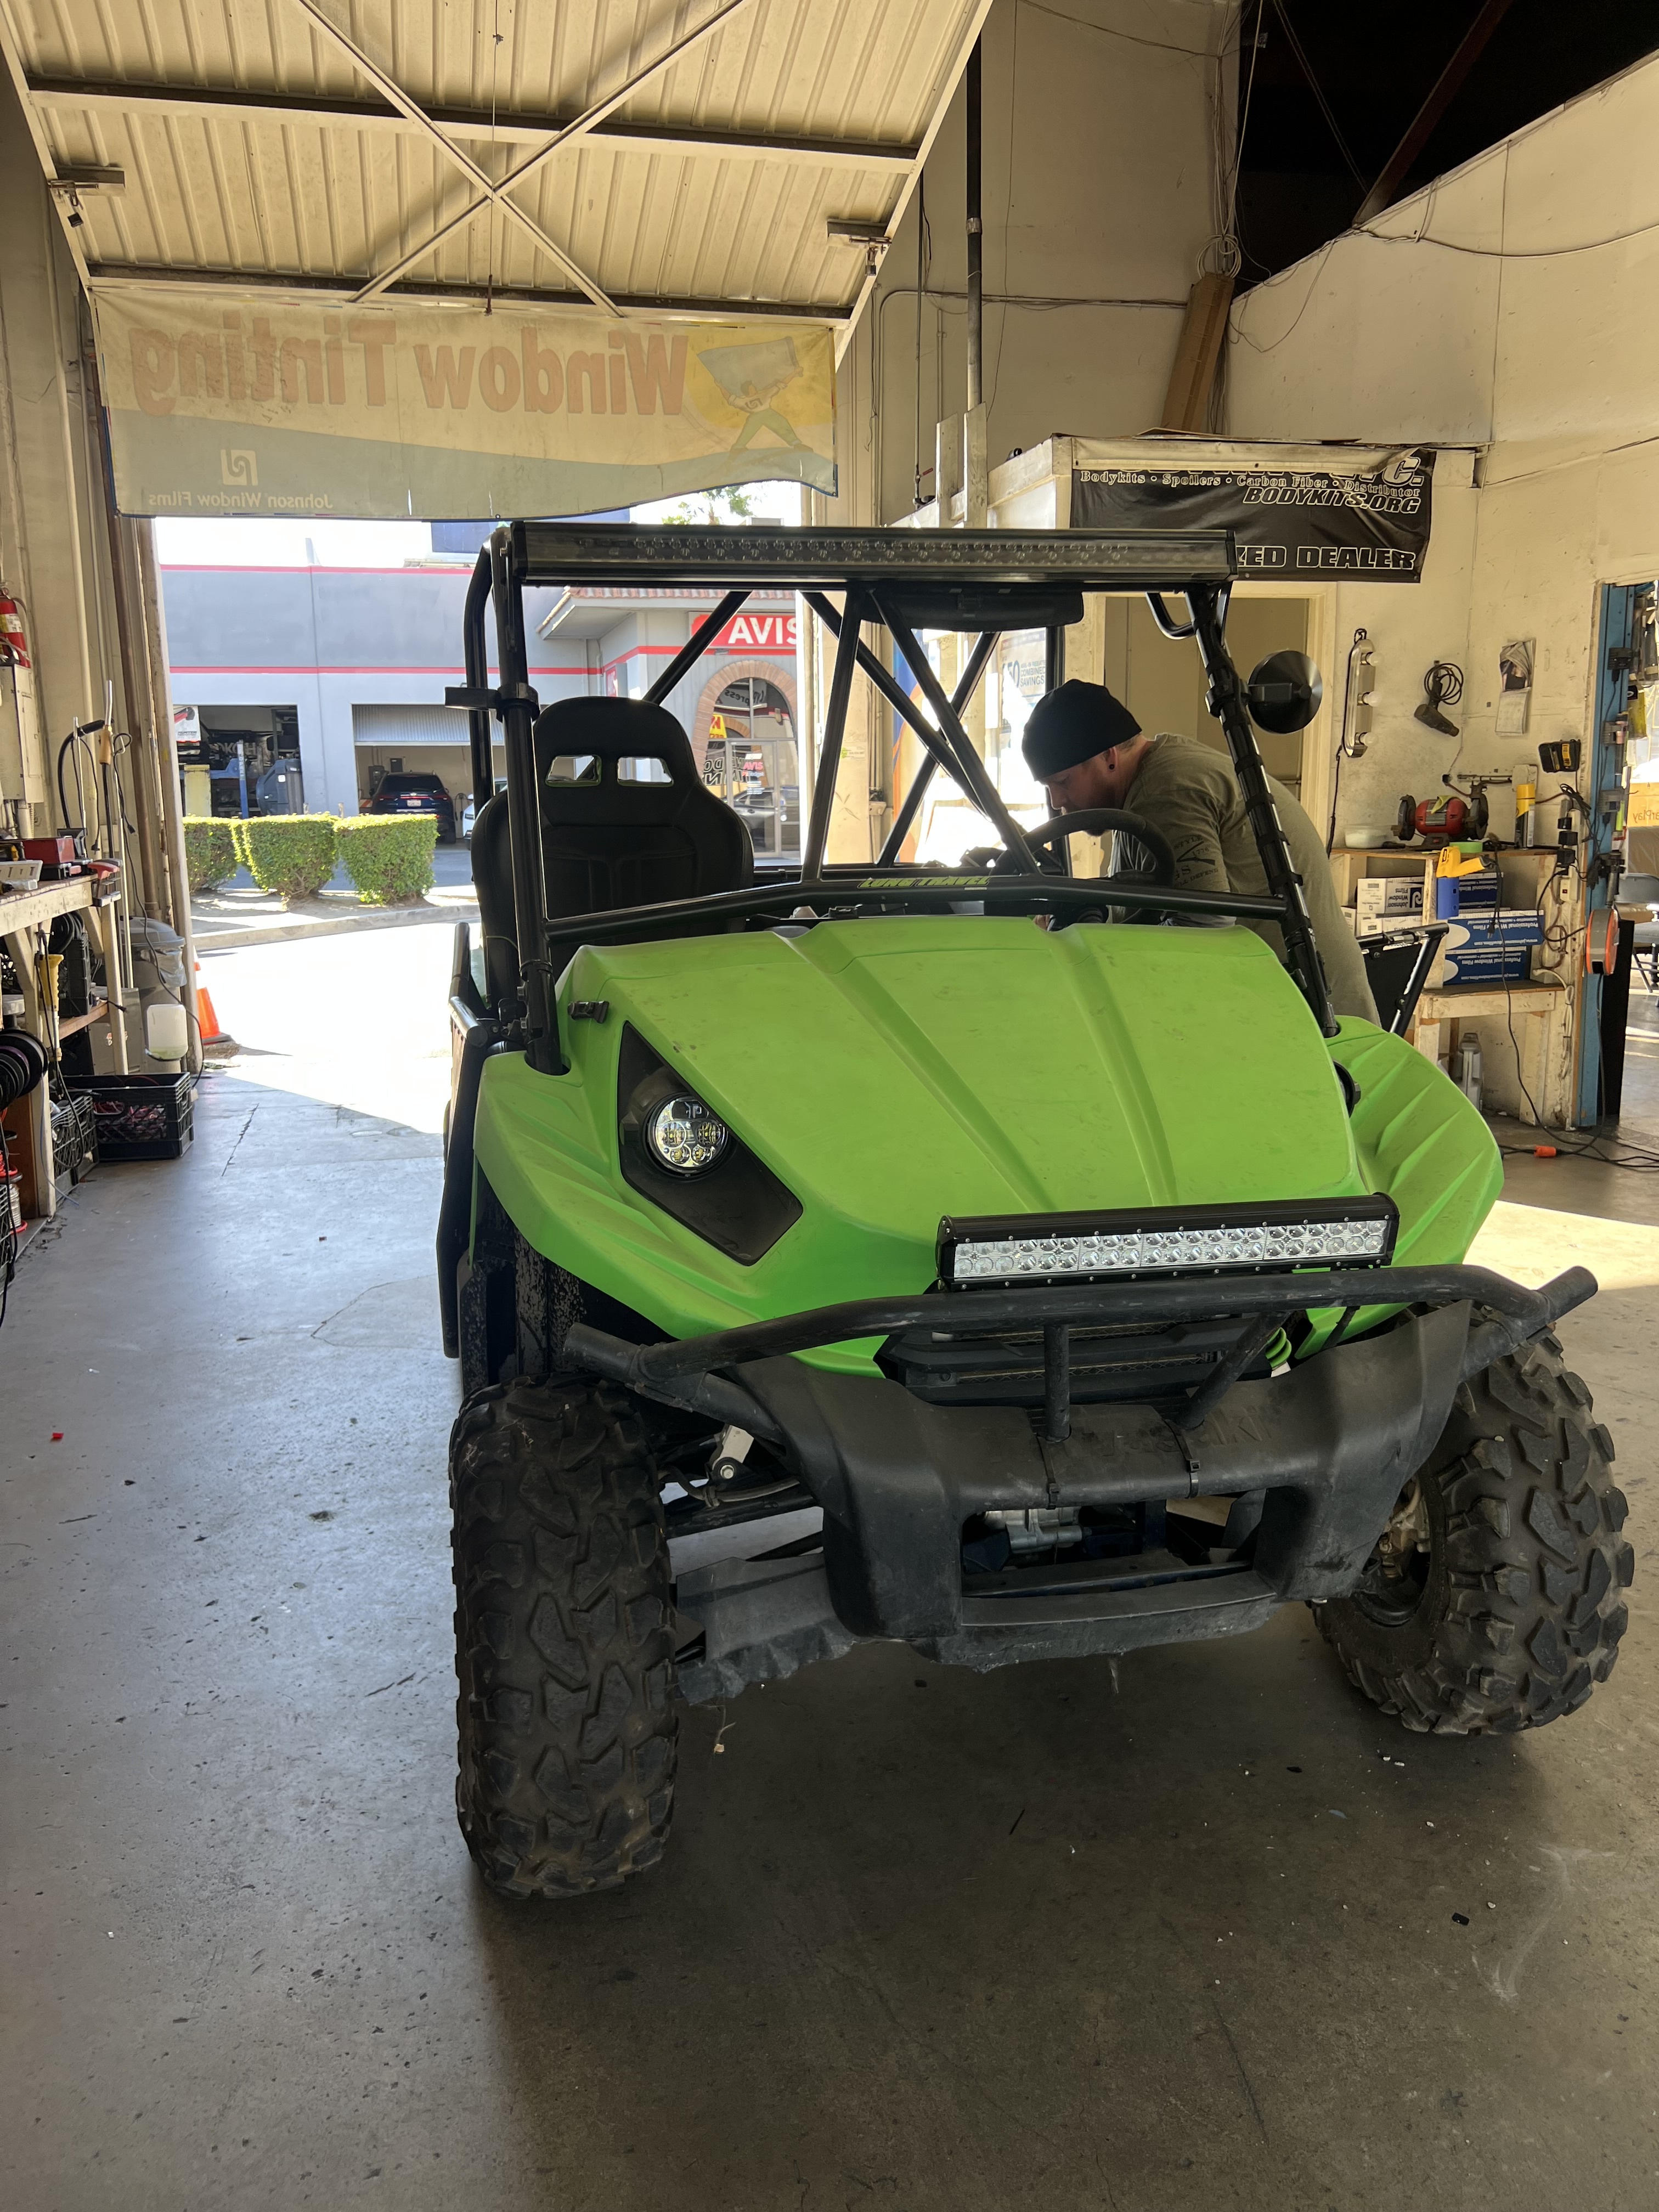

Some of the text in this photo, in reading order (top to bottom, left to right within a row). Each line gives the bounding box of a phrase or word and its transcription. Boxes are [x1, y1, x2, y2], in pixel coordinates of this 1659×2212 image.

[1080, 470, 1146, 486] Bodykits
[1162, 473, 1221, 488] Spoilers
[1237, 475, 1287, 487] Carbon
[1291, 476, 1329, 489] Fiber
[1344, 480, 1420, 498] Distributor
[1243, 487, 1421, 514] BODYKITS.ORG
[1296, 546, 1416, 570] DEALER
[1020, 675, 1045, 687] SAVINGS
